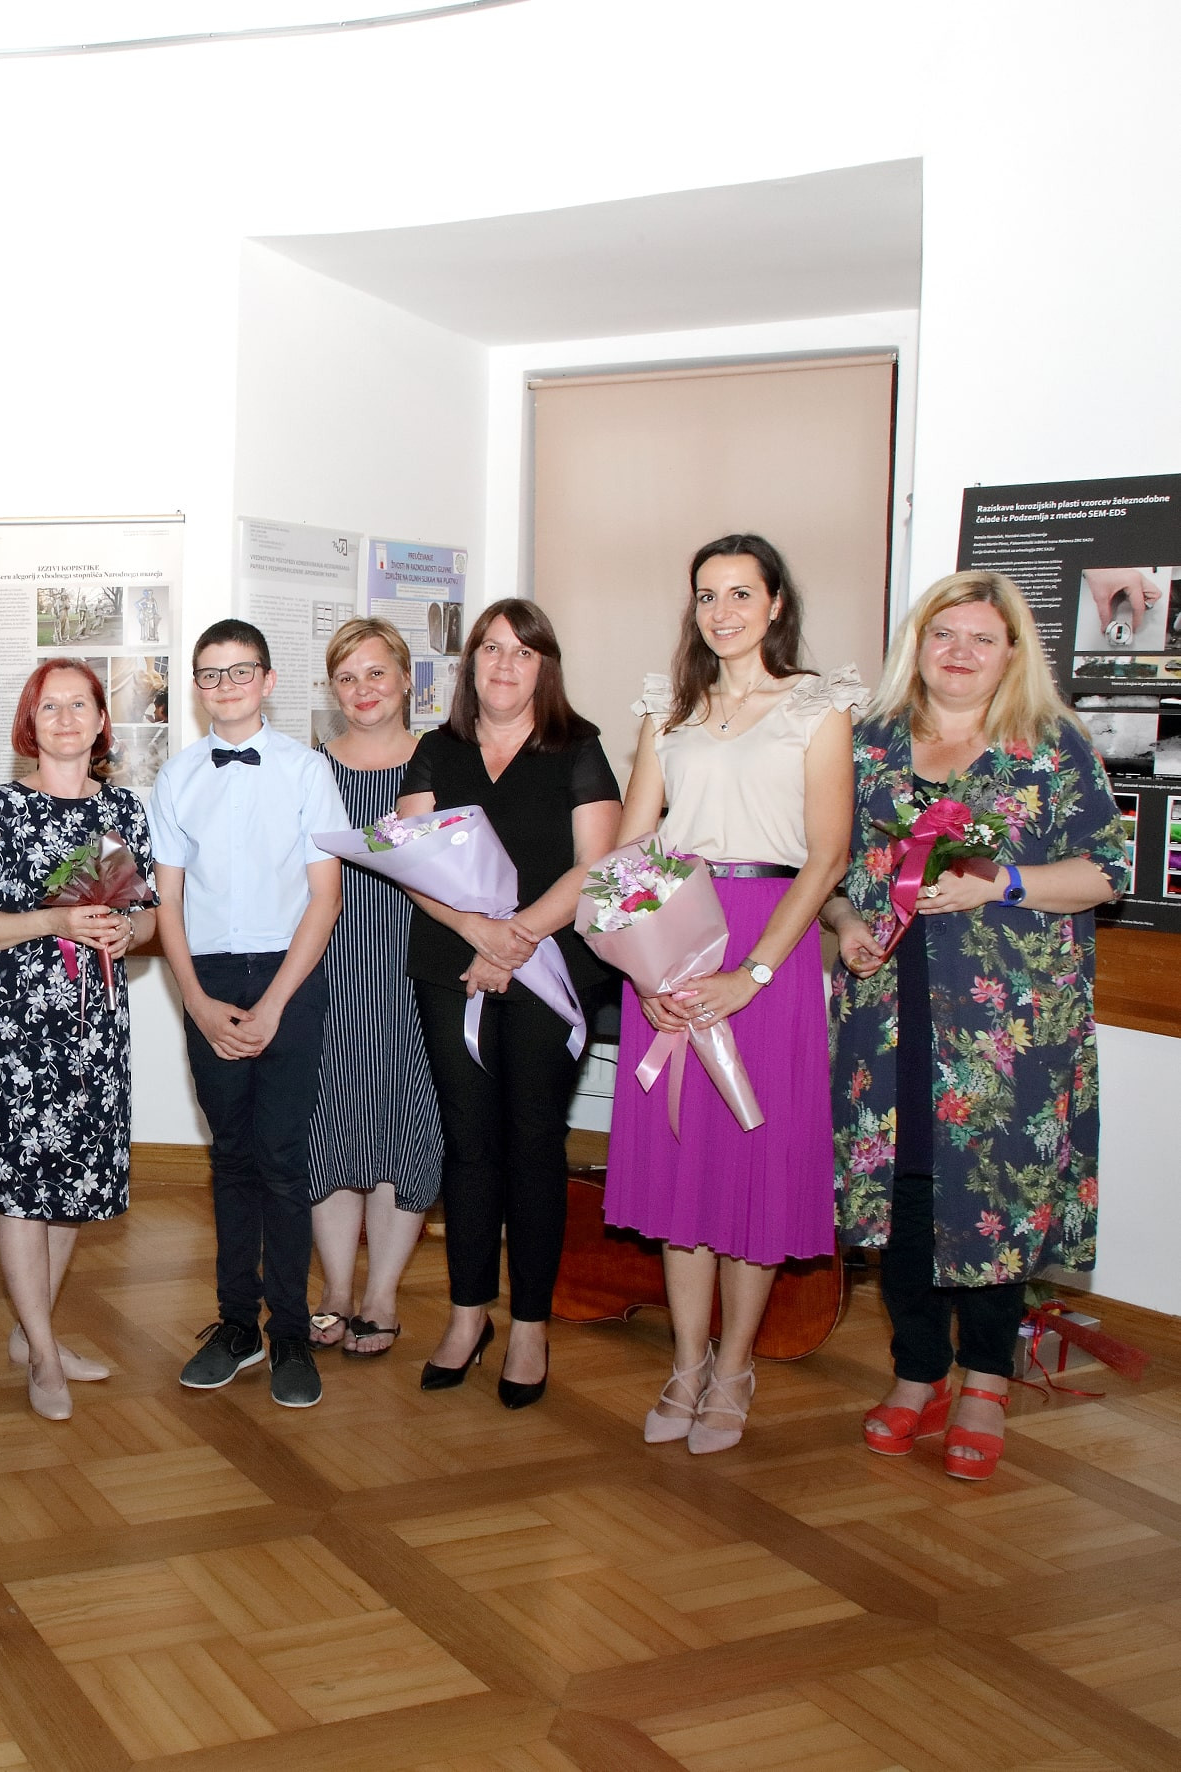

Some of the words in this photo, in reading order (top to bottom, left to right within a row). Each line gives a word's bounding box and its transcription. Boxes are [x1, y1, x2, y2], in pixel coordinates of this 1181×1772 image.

[977, 504, 1014, 512] Raziskave
[1015, 502, 1057, 512] korozijskih
[1057, 500, 1080, 510] plasti
[1081, 498, 1111, 507] vzorcev
[1112, 494, 1170, 505] železnodobne
[975, 515, 1000, 524] čelade
[1001, 514, 1008, 522] iz
[1009, 511, 1049, 523] Podzemlja
[1055, 511, 1087, 520] metodo
[1088, 508, 1127, 518] SEM-EDS
[72, 571, 103, 579] stopnišča
[103, 571, 139, 579] Narodnega
